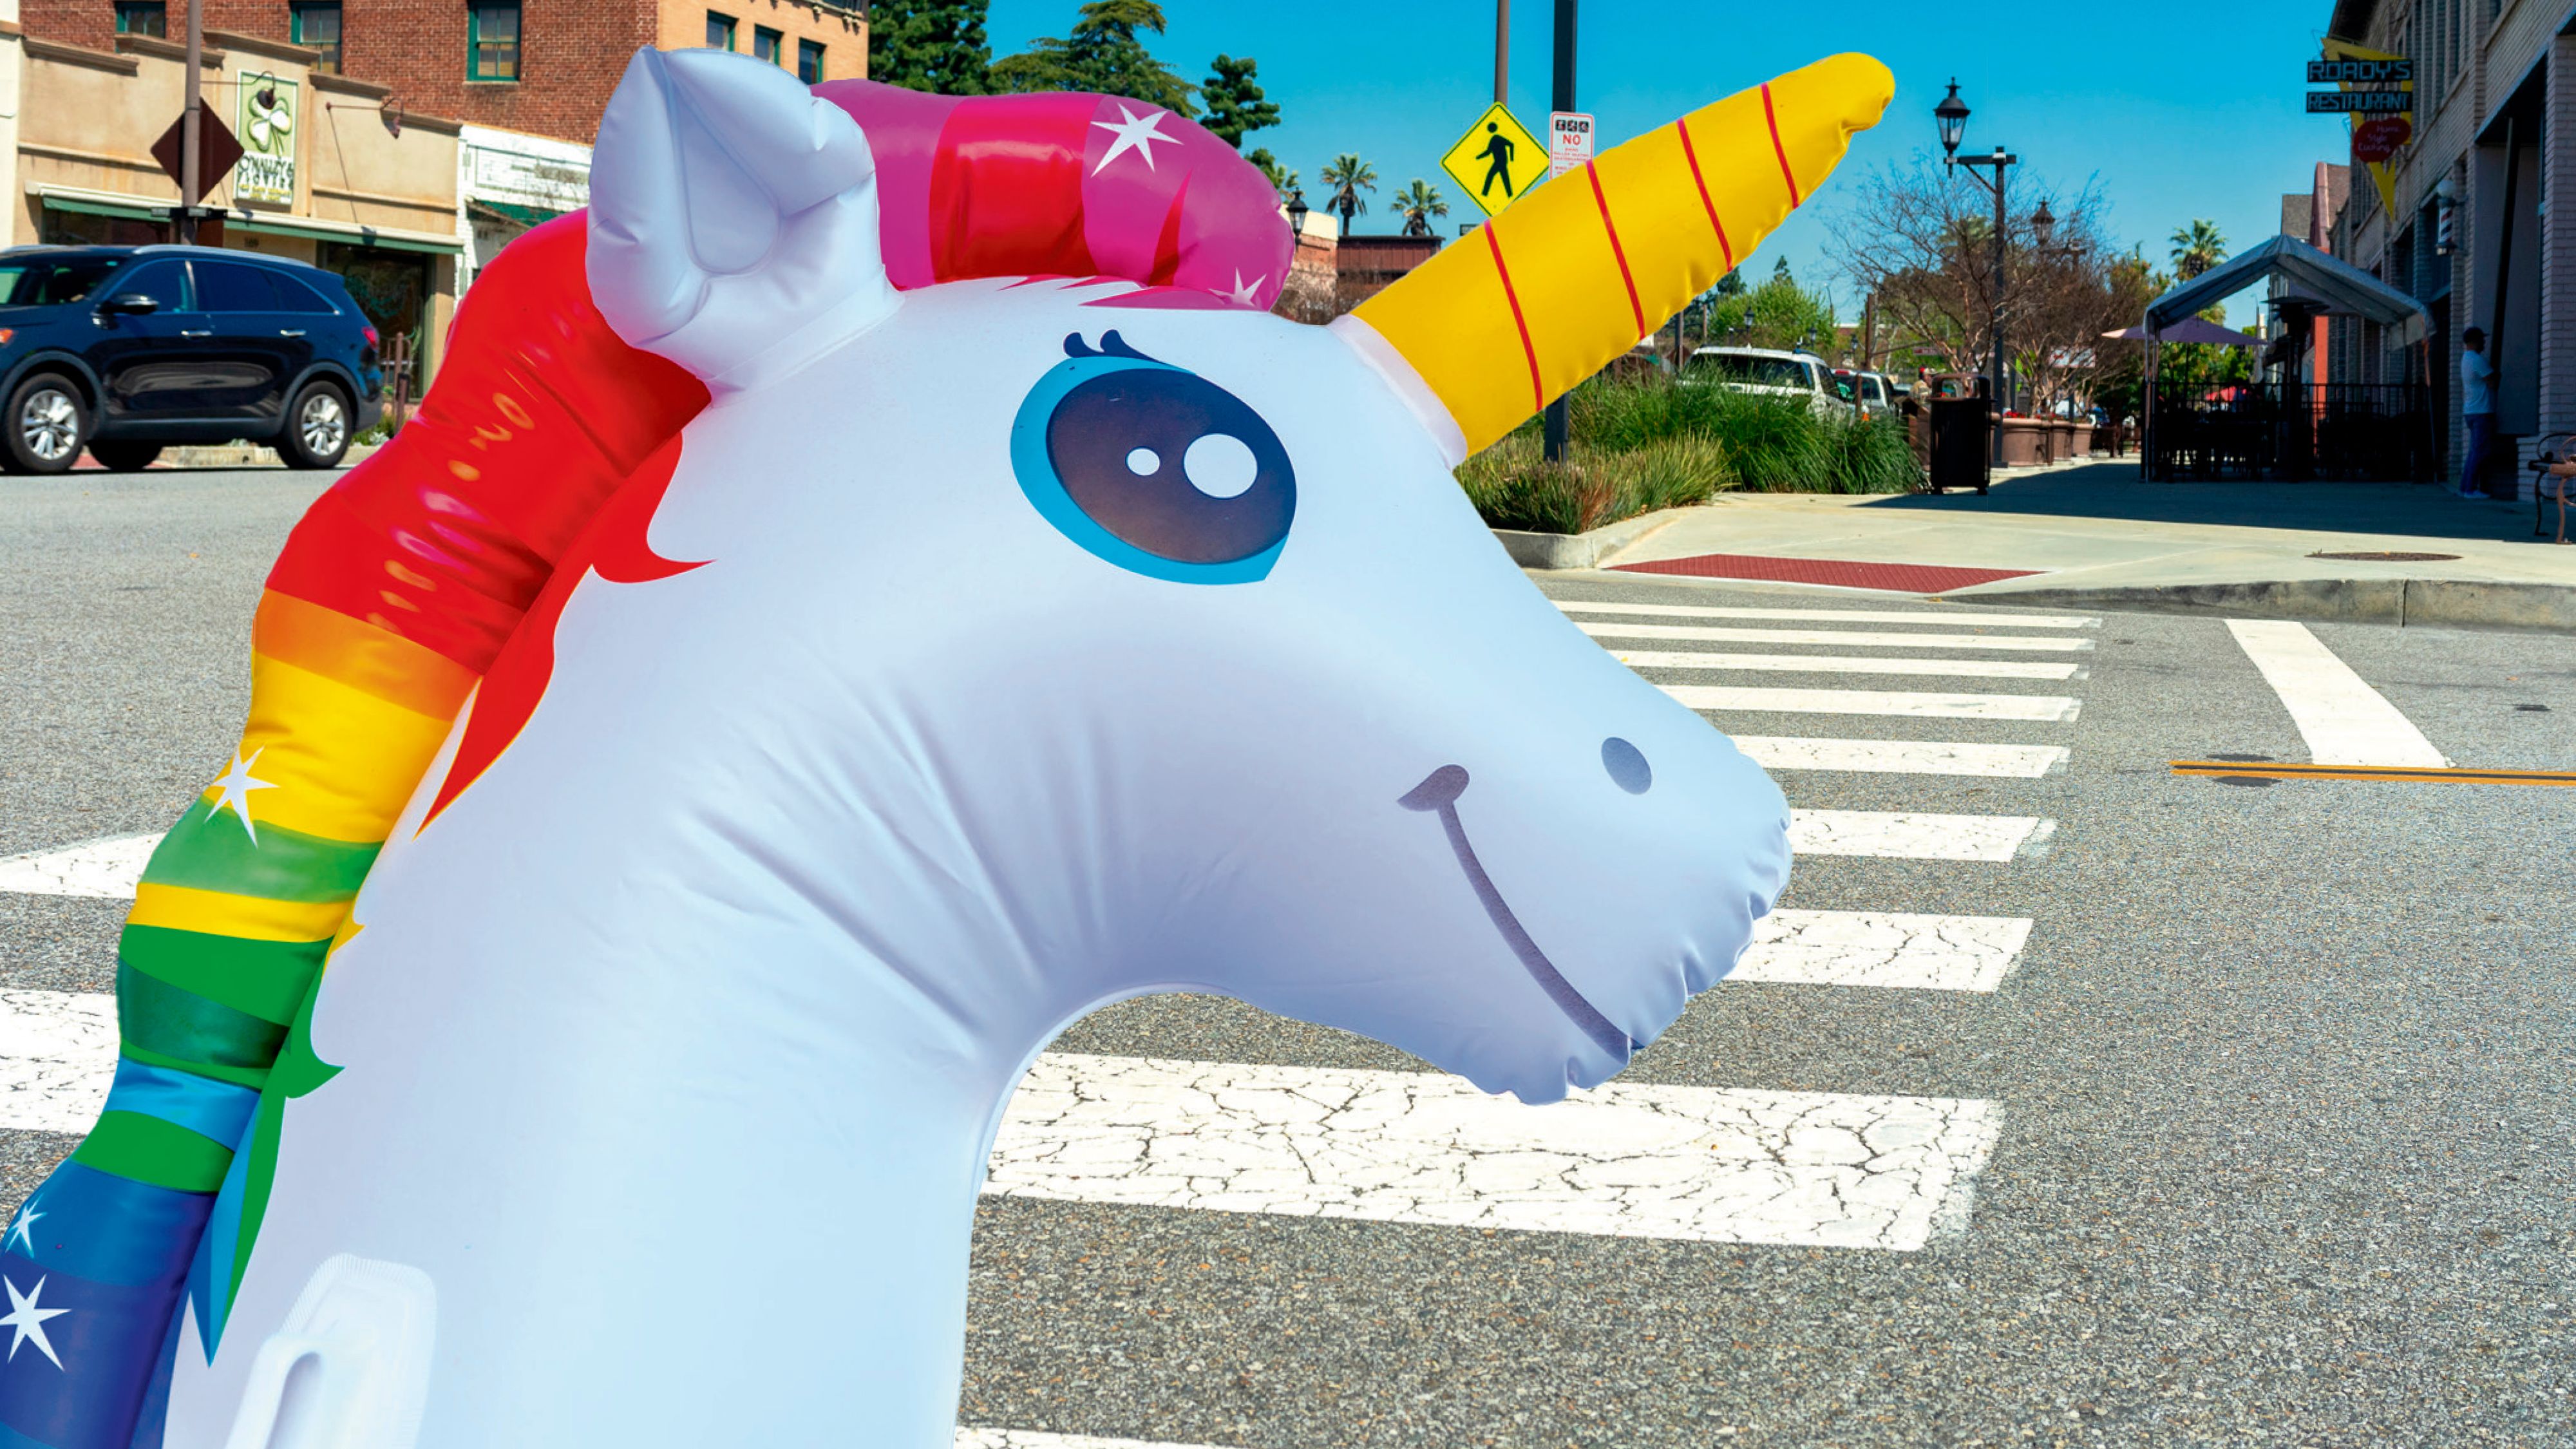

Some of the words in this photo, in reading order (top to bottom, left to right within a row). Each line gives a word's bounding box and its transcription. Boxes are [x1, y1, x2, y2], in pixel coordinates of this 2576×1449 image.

[2309, 61, 2410, 79] ROADY'S
[2307, 93, 2407, 109] RESTAURANT
[1562, 133, 1581, 145] NO
[2367, 133, 2387, 143] Style
[2358, 143, 2391, 153] Cooking
